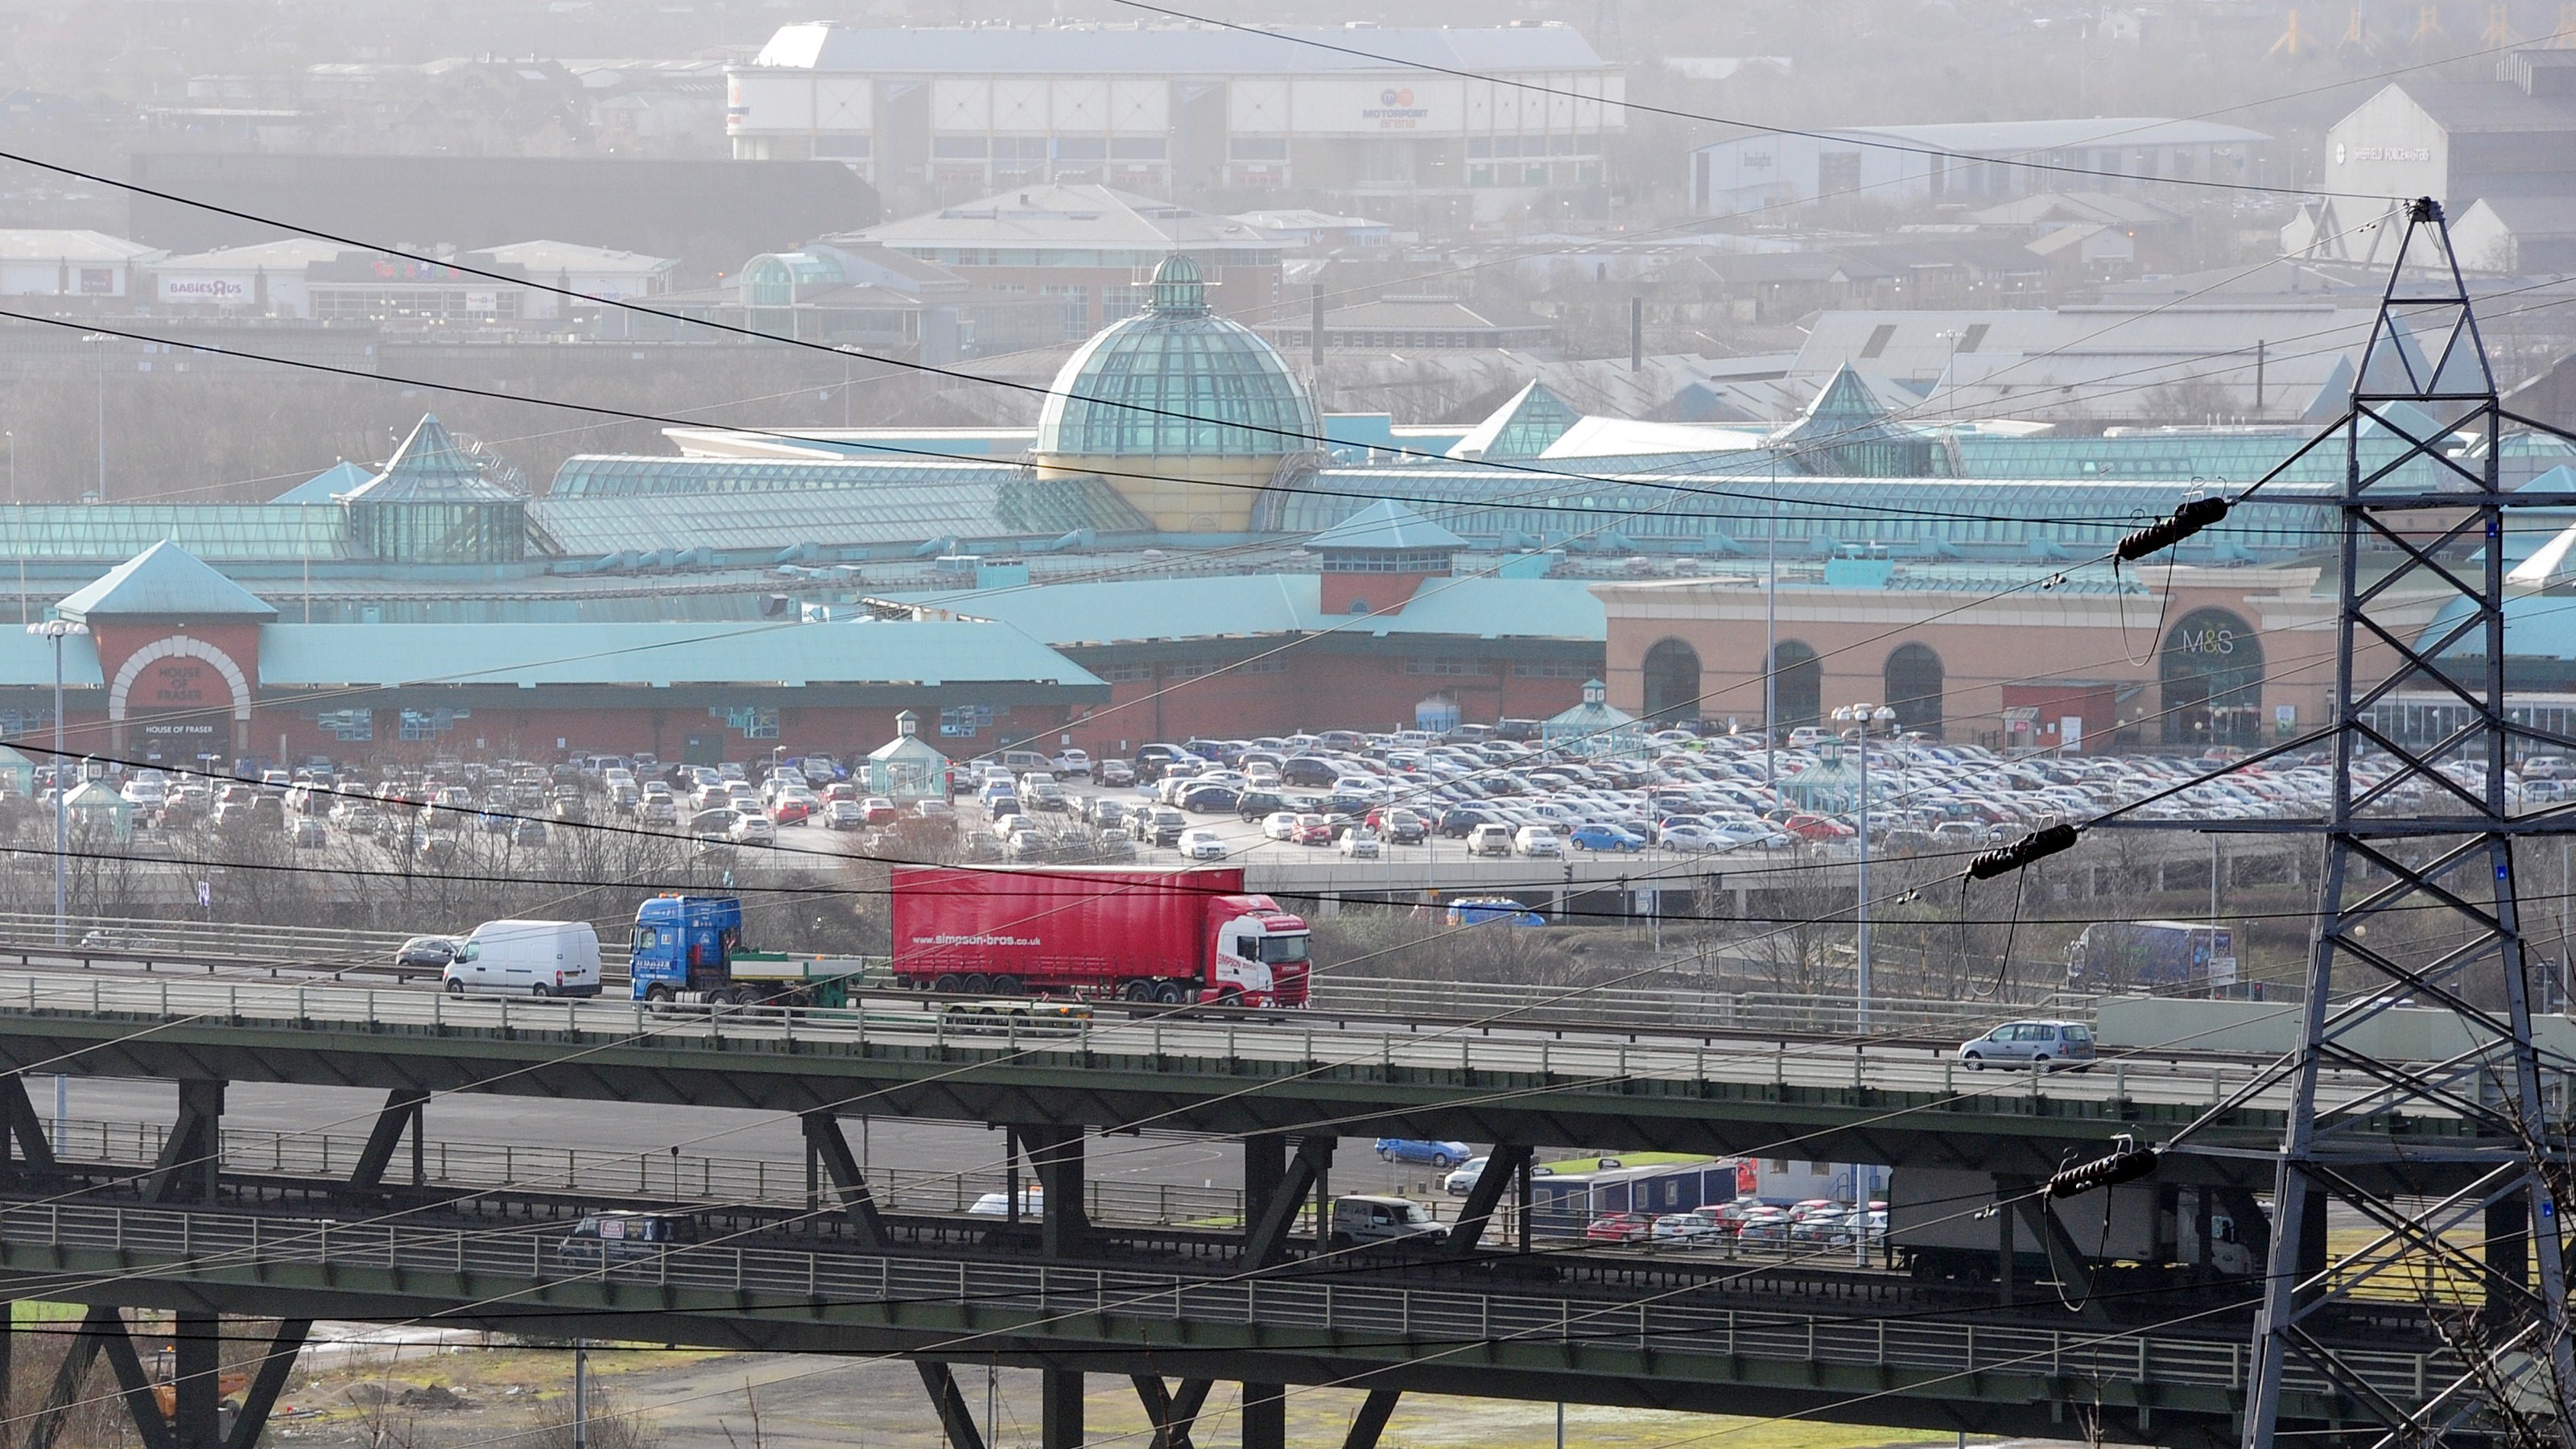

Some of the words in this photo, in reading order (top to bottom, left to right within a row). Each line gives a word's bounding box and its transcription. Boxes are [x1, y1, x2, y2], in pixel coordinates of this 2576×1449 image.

[1362, 109, 1428, 118] MOTORPOINT
[1381, 119, 1415, 129] arena
[2354, 147, 2383, 160] SHEFFIELD
[1744, 151, 1772, 171] Insight
[2183, 630, 2234, 654] M&S
[159, 667, 201, 678] HOUSE
[171, 679, 188, 689] OF
[157, 690, 201, 700] FRASER
[146, 725, 171, 733] HOUSE
[173, 725, 184, 733] OF
[186, 725, 213, 733] FRASER
[1218, 952, 1241, 968] SIMPSON
